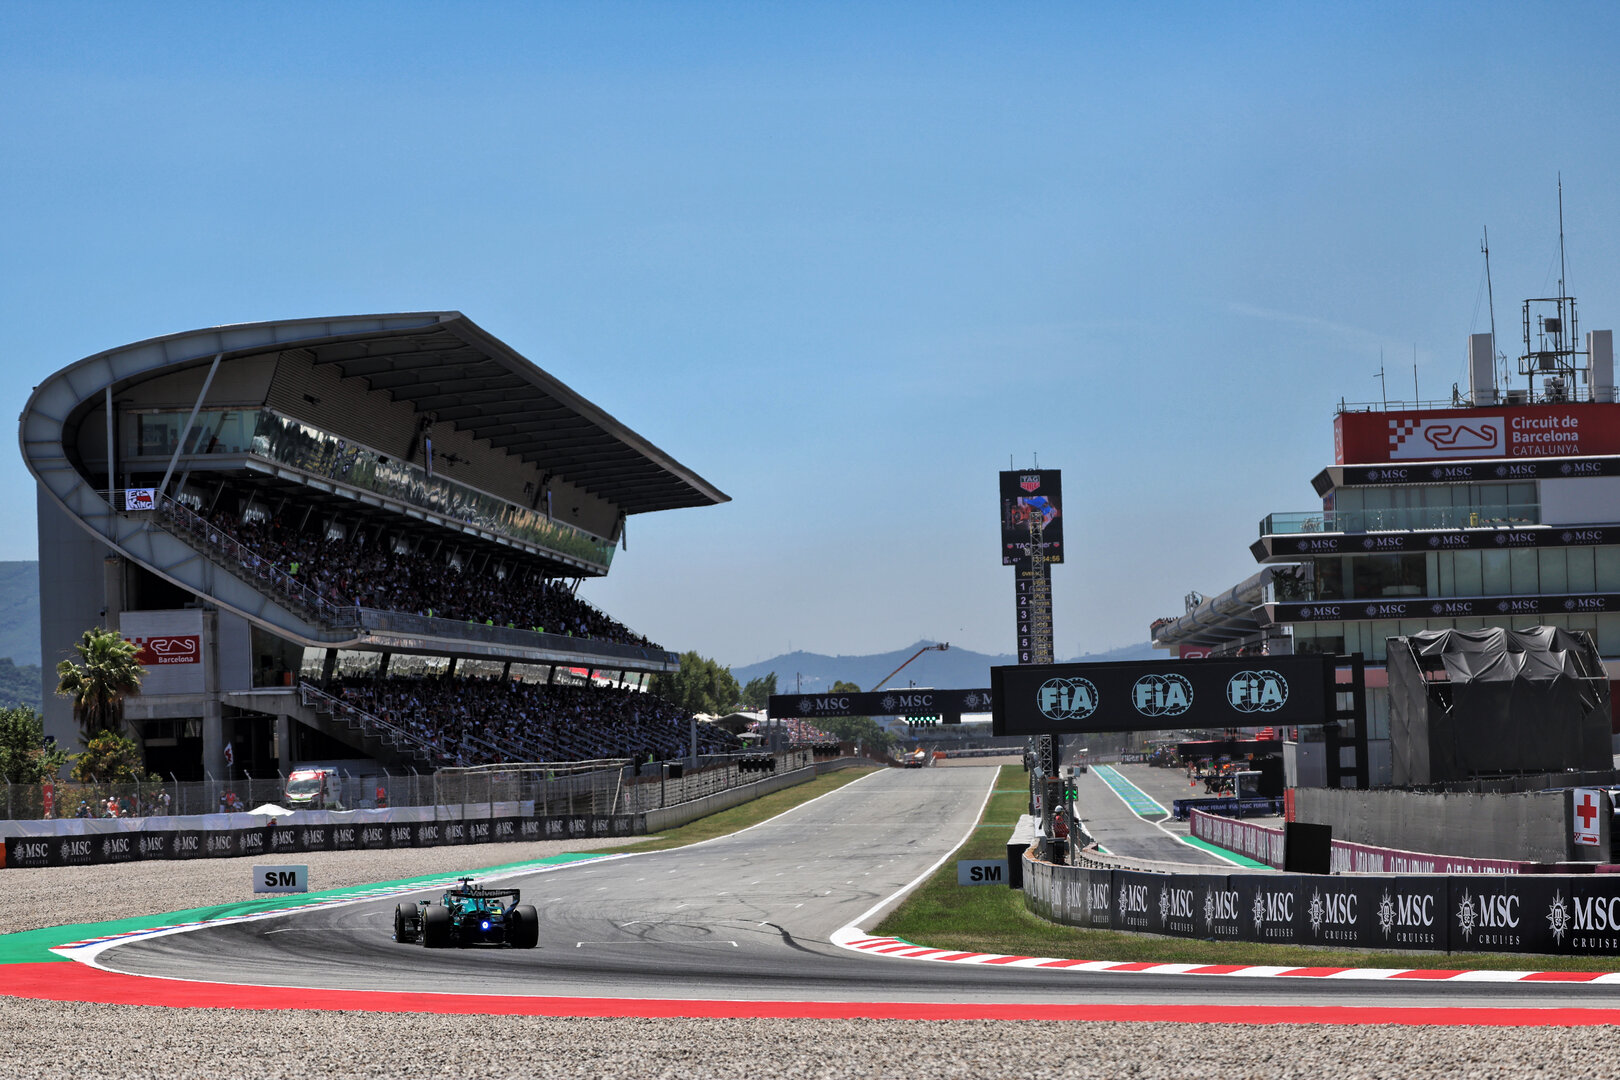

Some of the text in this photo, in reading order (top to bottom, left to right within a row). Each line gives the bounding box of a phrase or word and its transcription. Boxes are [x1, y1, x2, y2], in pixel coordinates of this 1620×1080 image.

[1512, 415, 1578, 429] Circuit de
[1512, 430, 1579, 443] Barcelona
[1512, 444, 1580, 456] CATALUNYA
[1445, 467, 1472, 477] MSC
[1510, 464, 1537, 474] MSC
[1574, 462, 1601, 472] MSC
[1381, 470, 1408, 479] MSC
[1376, 536, 1404, 546] MSC
[1442, 534, 1470, 544] MSC
[1509, 532, 1536, 542] MSC
[1575, 530, 1602, 540] MSC
[1311, 539, 1338, 549] MSC
[1020, 582, 1025, 590] 1
[1020, 596, 1026, 604] 2
[1512, 600, 1538, 610] MSC
[1578, 598, 1605, 608] MSC
[1313, 606, 1340, 616] MSC
[1380, 604, 1406, 614] MSC
[1445, 602, 1472, 612] MSC
[1021, 610, 1027, 618] 3
[1022, 624, 1028, 632] 4
[1022, 638, 1028, 646] 5
[1022, 652, 1028, 660] 6
[816, 698, 850, 710] MSC
[900, 695, 933, 707] MSC
[424, 826, 438, 839] MSC
[451, 824, 464, 838] MSC
[476, 824, 488, 836] MSC
[502, 822, 514, 834] MSC
[526, 821, 539, 833] MSC
[246, 833, 262, 846] MSC
[278, 831, 294, 844] MSC
[310, 830, 324, 842] MSC
[340, 829, 354, 842] MSC
[368, 828, 382, 840] MSC
[396, 828, 410, 840] MSC
[71, 841, 92, 856] MSC
[111, 838, 130, 852] MSC
[147, 836, 164, 850] MSC
[182, 837, 198, 850] MSC
[214, 836, 231, 850] MSC
[26, 844, 48, 858] MSC
[264, 872, 296, 886] SM
[970, 866, 1002, 882] SM
[1094, 883, 1108, 910] MSC
[1128, 884, 1148, 912] MSC
[1170, 888, 1194, 918] MSC
[1215, 891, 1239, 920] MSC
[1266, 892, 1294, 922] MSC
[1326, 893, 1358, 924] MSC
[1397, 894, 1434, 926] MSC
[1479, 895, 1520, 928] MSC
[1573, 896, 1620, 930] MSC
[1128, 918, 1148, 926] CRUISES
[1170, 922, 1194, 932] CRUISES
[1214, 925, 1238, 934] CRUISES
[1266, 928, 1294, 937] CRUISES
[1325, 930, 1358, 940] CRUISES
[1396, 932, 1434, 942] CRUISES
[1573, 938, 1618, 948] CRUISE
